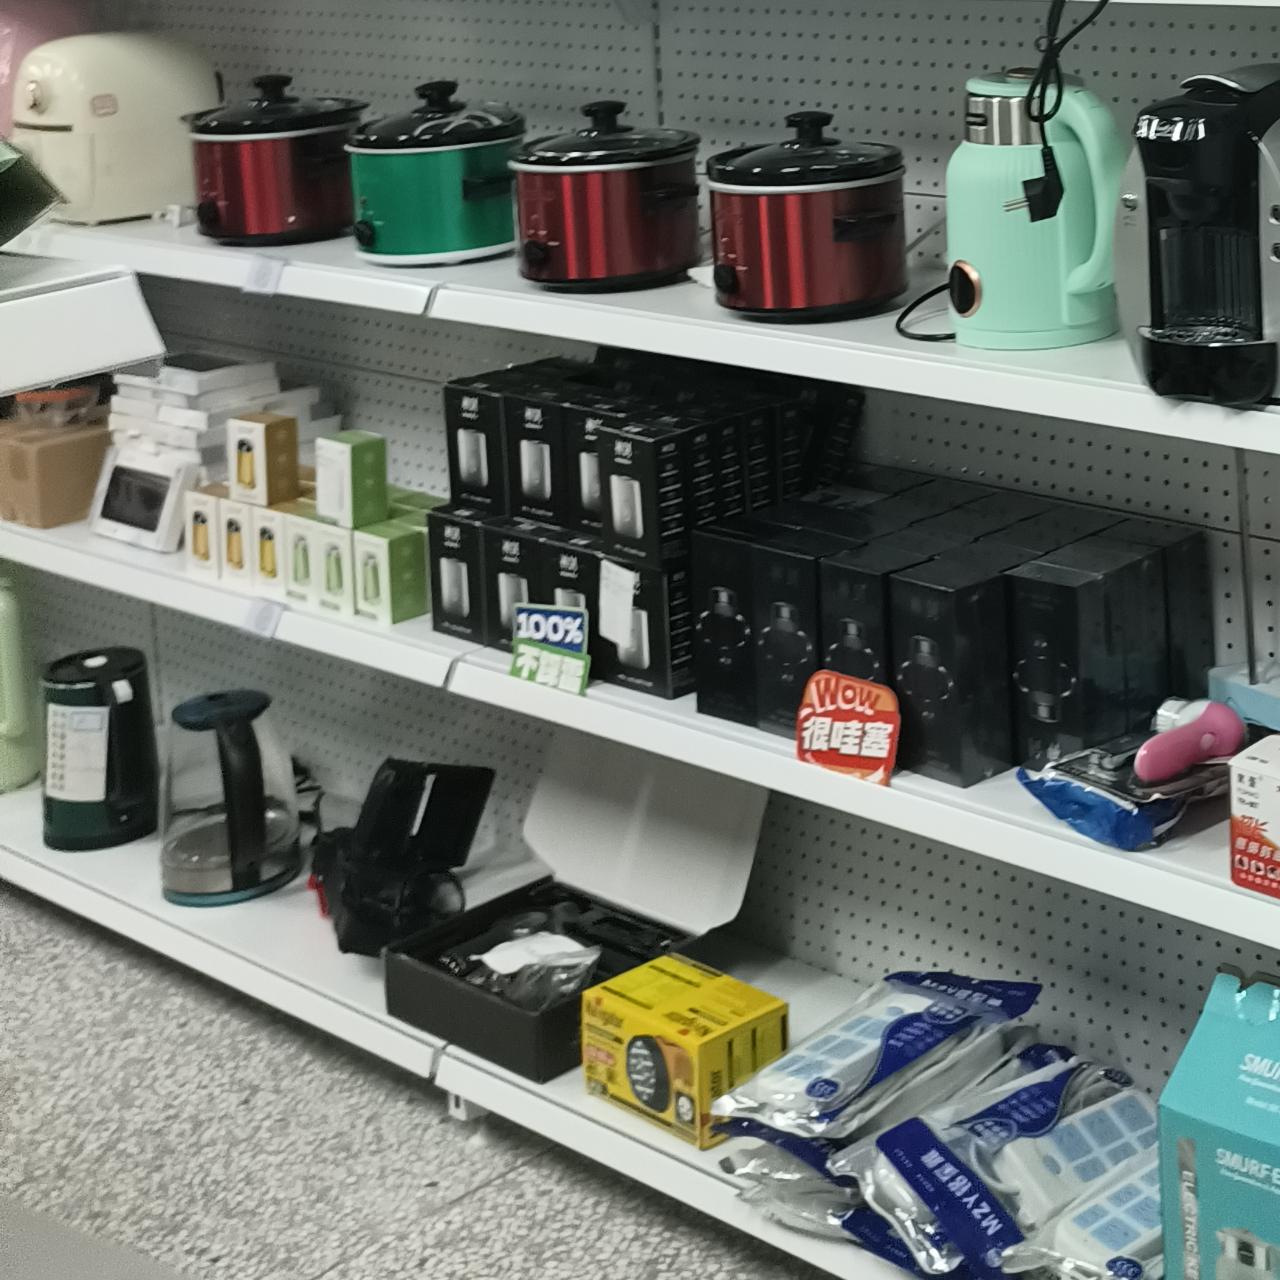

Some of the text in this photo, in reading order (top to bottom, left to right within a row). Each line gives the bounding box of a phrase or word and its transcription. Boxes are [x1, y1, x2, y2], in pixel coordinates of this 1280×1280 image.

[517, 612, 584, 644] 100%
[802, 716, 895, 758] 很哇塞
